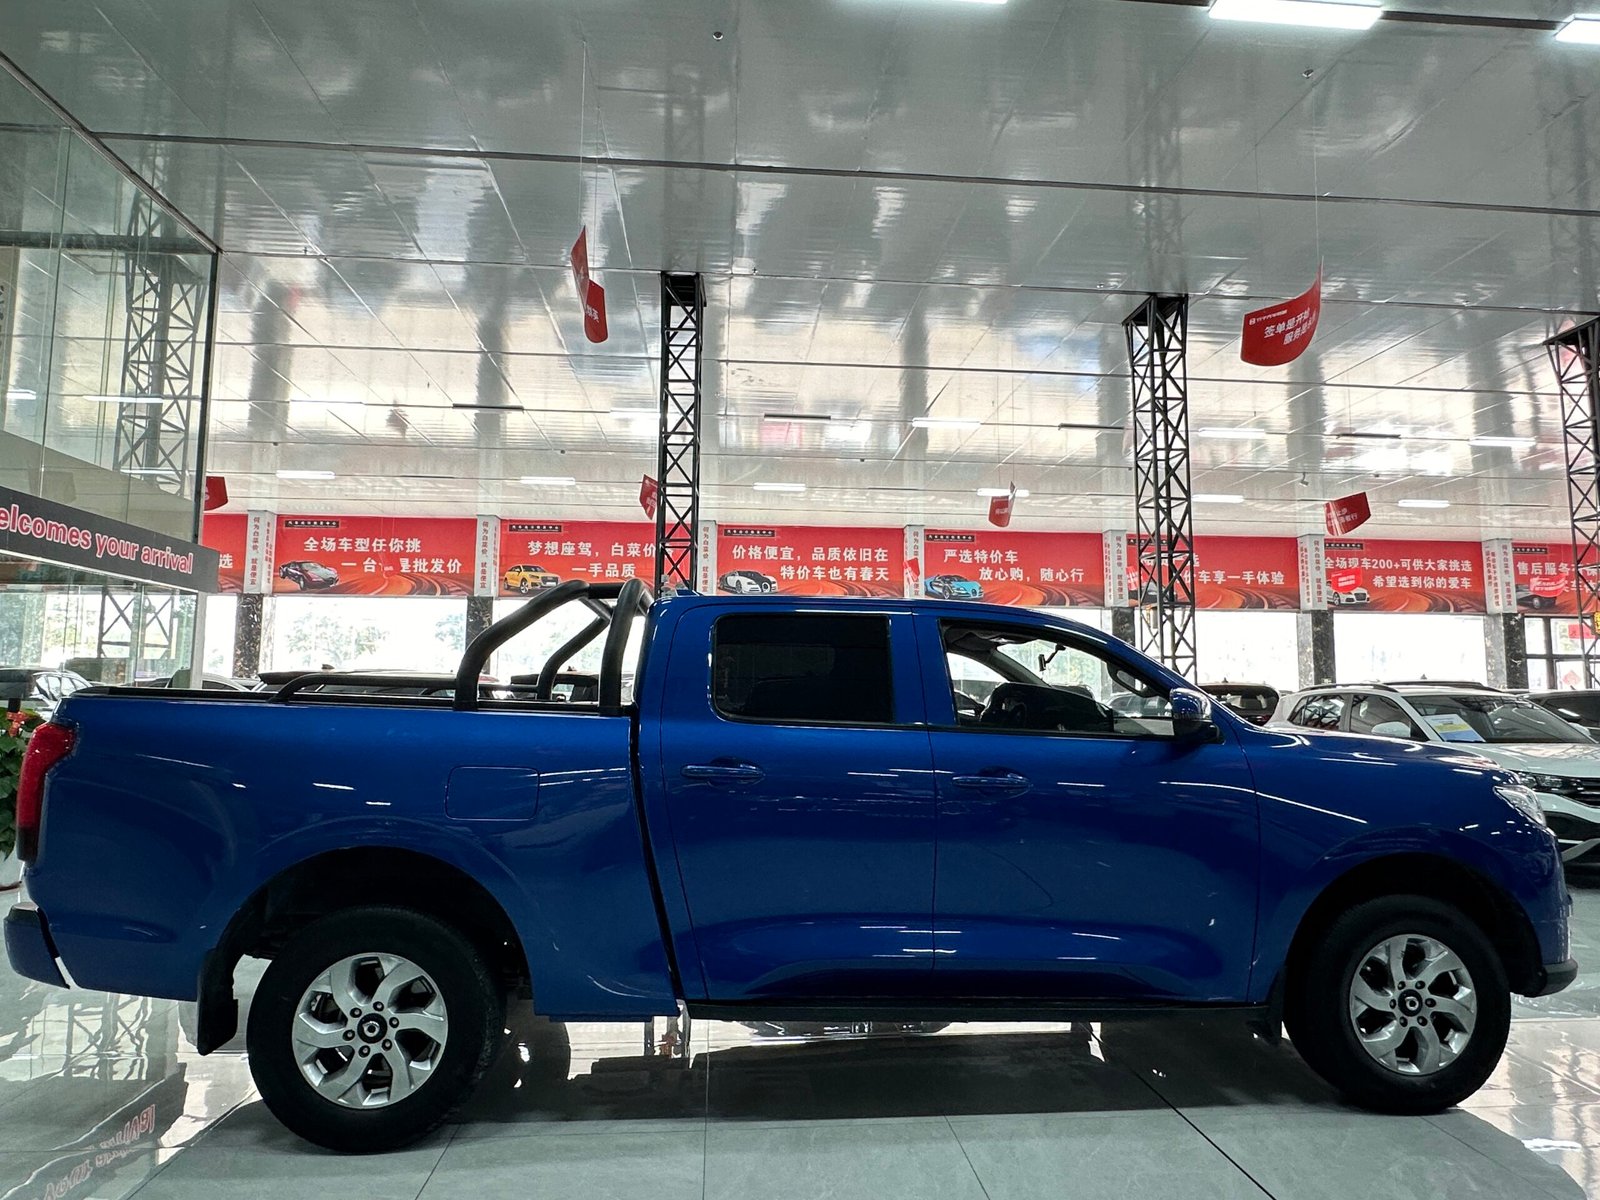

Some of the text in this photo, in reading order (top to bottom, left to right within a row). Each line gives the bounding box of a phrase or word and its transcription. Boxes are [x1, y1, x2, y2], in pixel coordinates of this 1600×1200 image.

[303, 537, 421, 553] 全场车型任你挑
[528, 541, 675, 558] 梦想座驾，白菜价
[732, 544, 889, 562] 价格便宜，品质依旧在
[95, 533, 139, 560] your
[141, 546, 194, 574] arrival
[943, 549, 1018, 564] 严选特价车
[341, 557, 462, 574] 一台是批发价
[571, 563, 637, 578] 一手品质
[1324, 556, 1473, 572] 全场现车200+可供大家挑选
[780, 566, 889, 581] 特价车也有春天
[979, 567, 1085, 583] 放心购，随心行
[1372, 575, 1472, 589] 希望选到你的爱车
